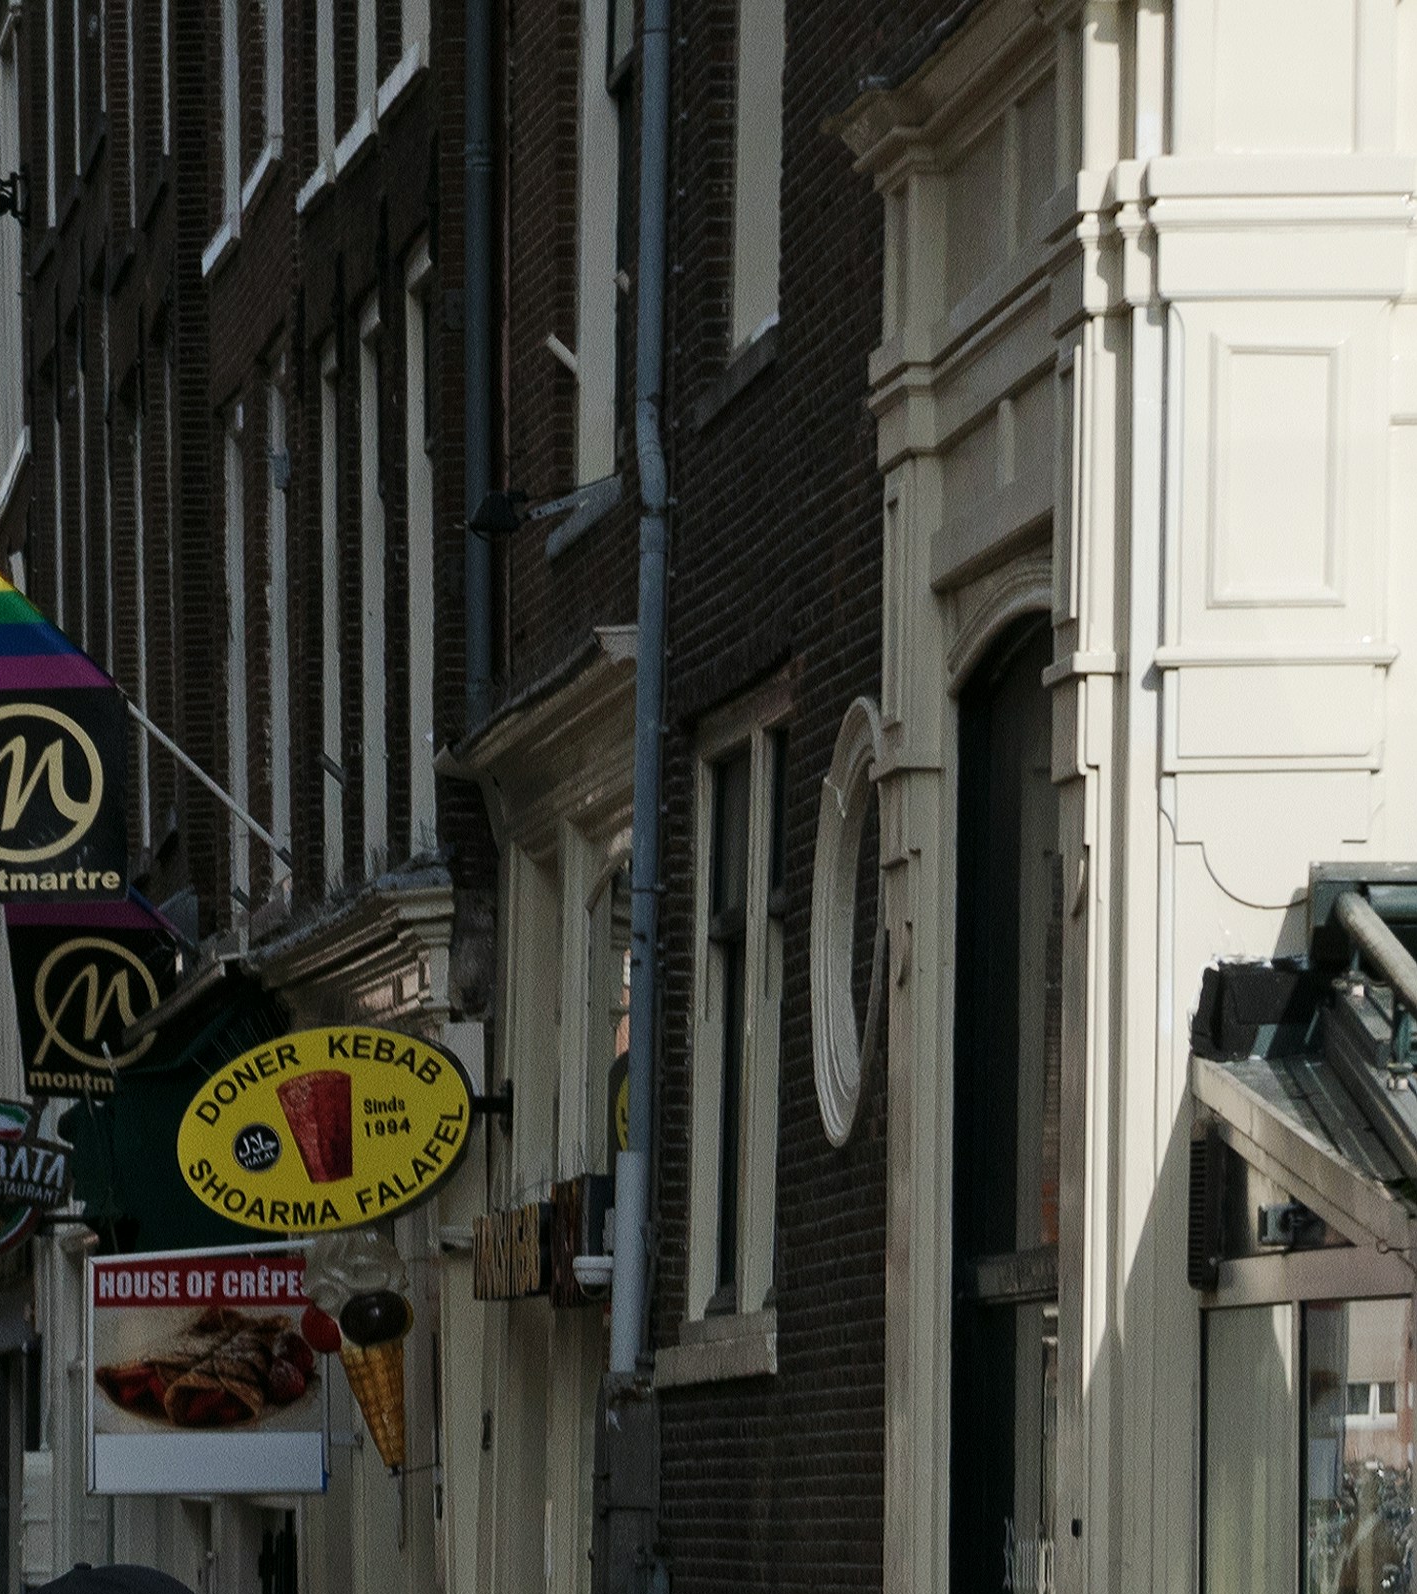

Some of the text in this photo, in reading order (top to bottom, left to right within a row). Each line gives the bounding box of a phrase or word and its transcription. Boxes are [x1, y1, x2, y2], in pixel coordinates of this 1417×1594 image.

[195, 1034, 443, 1127] DONER KEBAB
[364, 1093, 405, 1115] Sinds
[365, 1117, 412, 1138] 1994
[188, 1103, 464, 1226] SHOARMA FALAFEL
[244, 1150, 275, 1167] HALAL
[98, 1271, 180, 1298] HOUSE
[186, 1271, 216, 1297] OF
